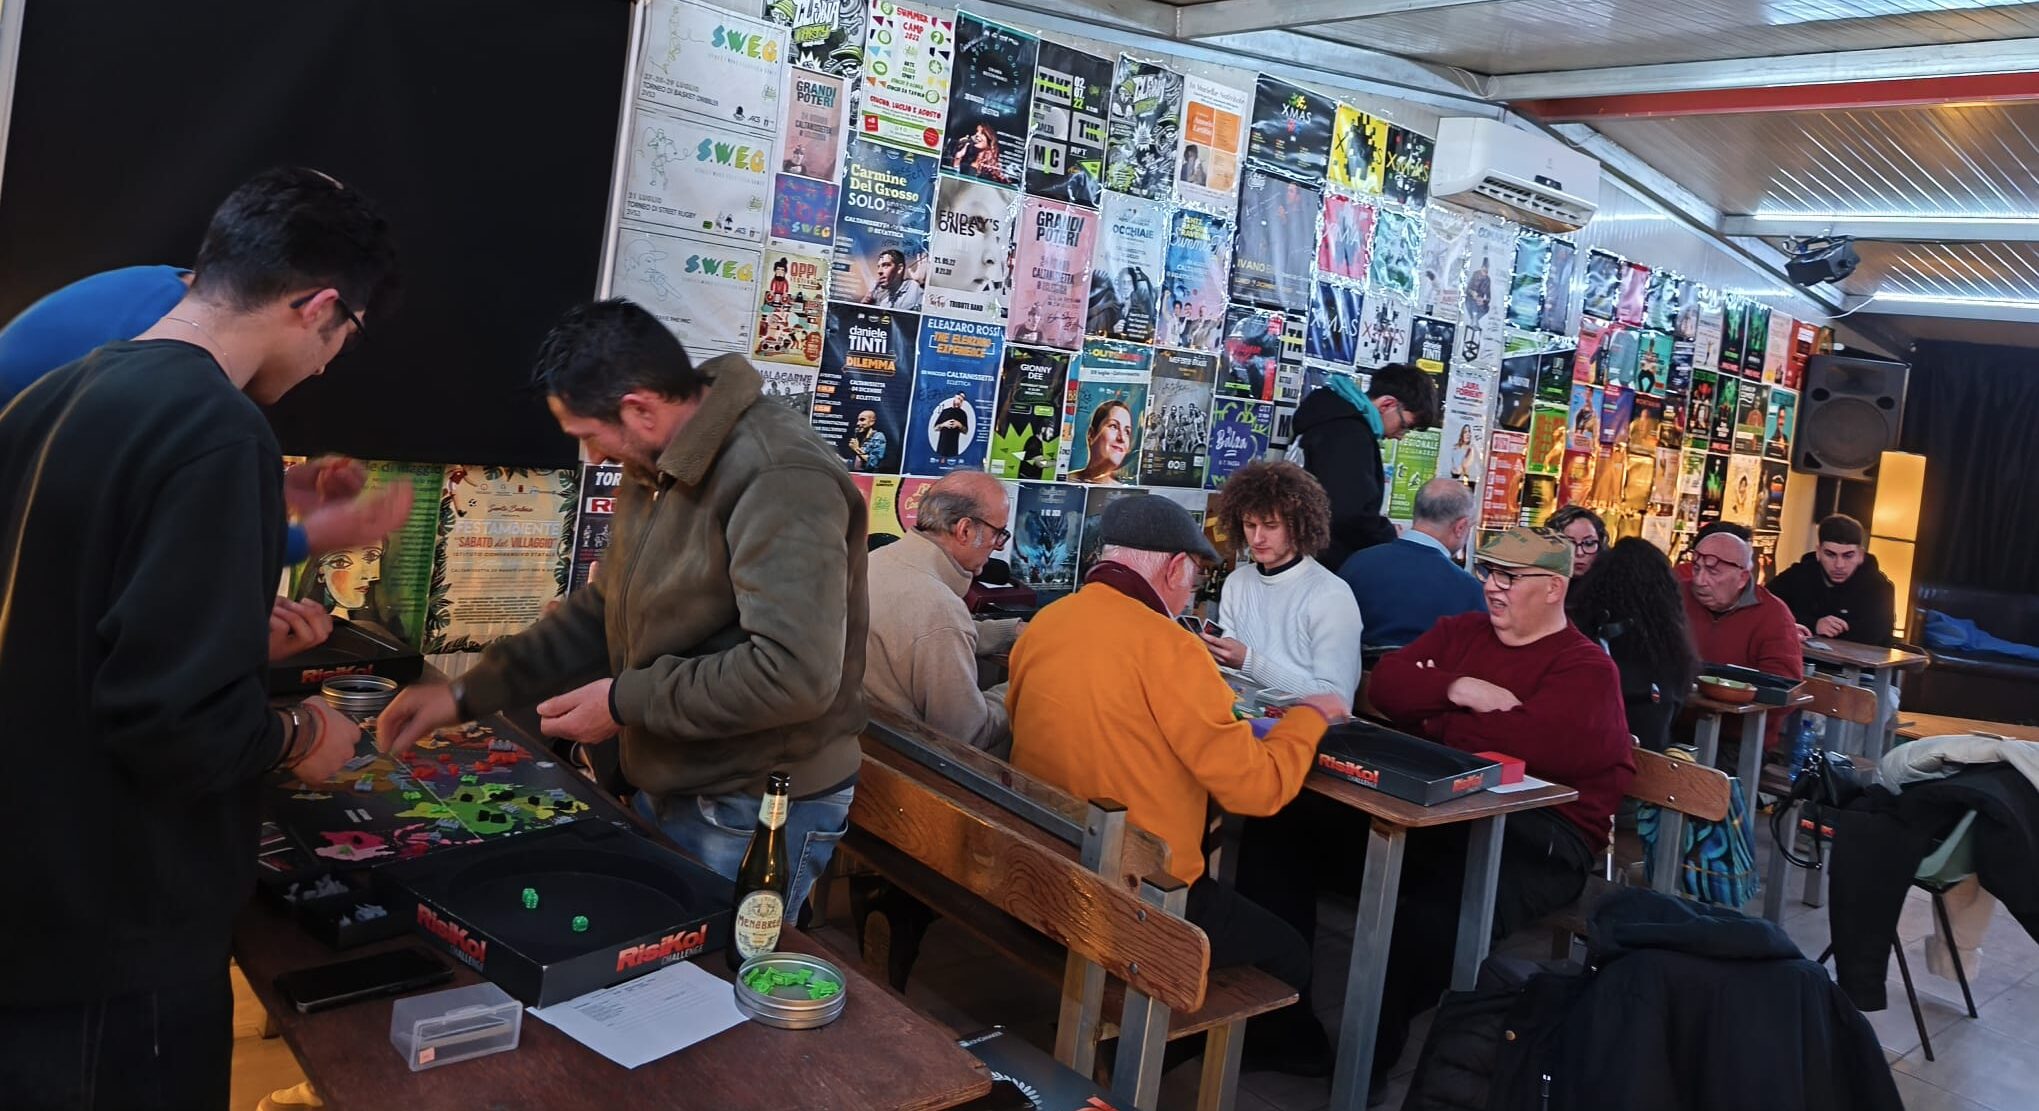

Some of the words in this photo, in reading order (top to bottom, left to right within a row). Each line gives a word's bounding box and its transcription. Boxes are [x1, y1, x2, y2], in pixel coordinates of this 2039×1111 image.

[903, 21, 925, 35] CAMP
[796, 80, 837, 98] GRANDI
[797, 91, 835, 108] POTERI
[918, 108, 941, 119] AGOSTO
[1281, 103, 1312, 124] XMAS
[850, 163, 908, 187] Carmine
[850, 178, 873, 193] Del
[874, 182, 919, 202] Grosso
[848, 192, 886, 211] SOLO
[938, 221, 976, 237] ONES
[939, 210, 1000, 232] FRIDAY'S
[849, 325, 888, 339] daniele
[928, 318, 974, 334] ELEAZARO
[976, 325, 1001, 337] ROSSI
[848, 335, 887, 353] TINTI
[846, 356, 896, 371] DILEMMA
[1020, 363, 1053, 374] GIONNY
[1027, 372, 1044, 381] DEE
[595, 471, 622, 486] TOR
[455, 520, 560, 536] FESTAMBIENTE
[616, 923, 708, 973] RisiKo!
